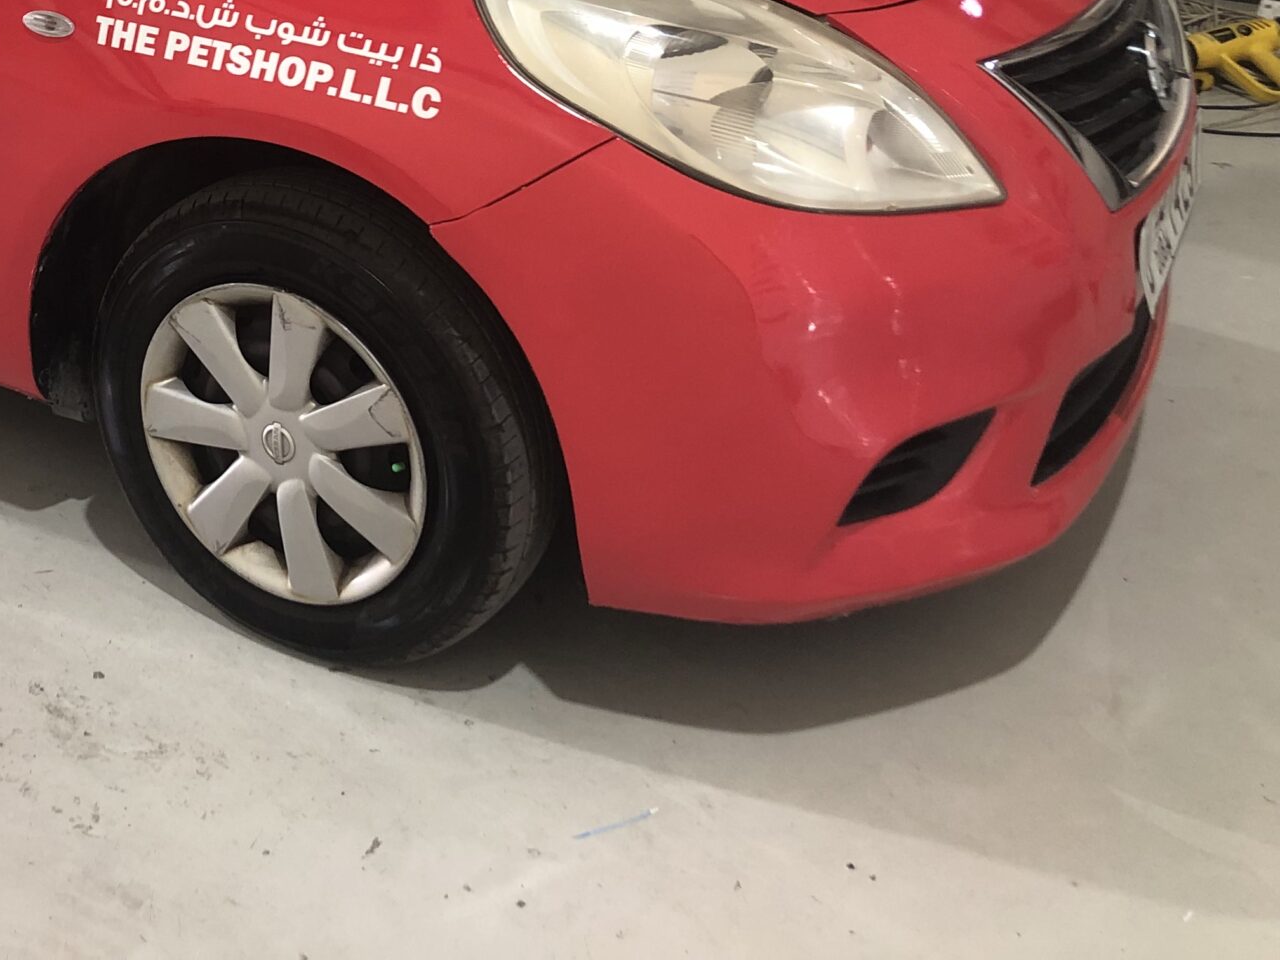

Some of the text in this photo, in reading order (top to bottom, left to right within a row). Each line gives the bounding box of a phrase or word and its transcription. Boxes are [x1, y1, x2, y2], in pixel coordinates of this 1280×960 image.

[244, 14, 332, 47] شوب
[95, 14, 442, 121] THE PETSHOP.L.L.C
[336, 31, 405, 70] بيت
[410, 42, 443, 75] ذا
